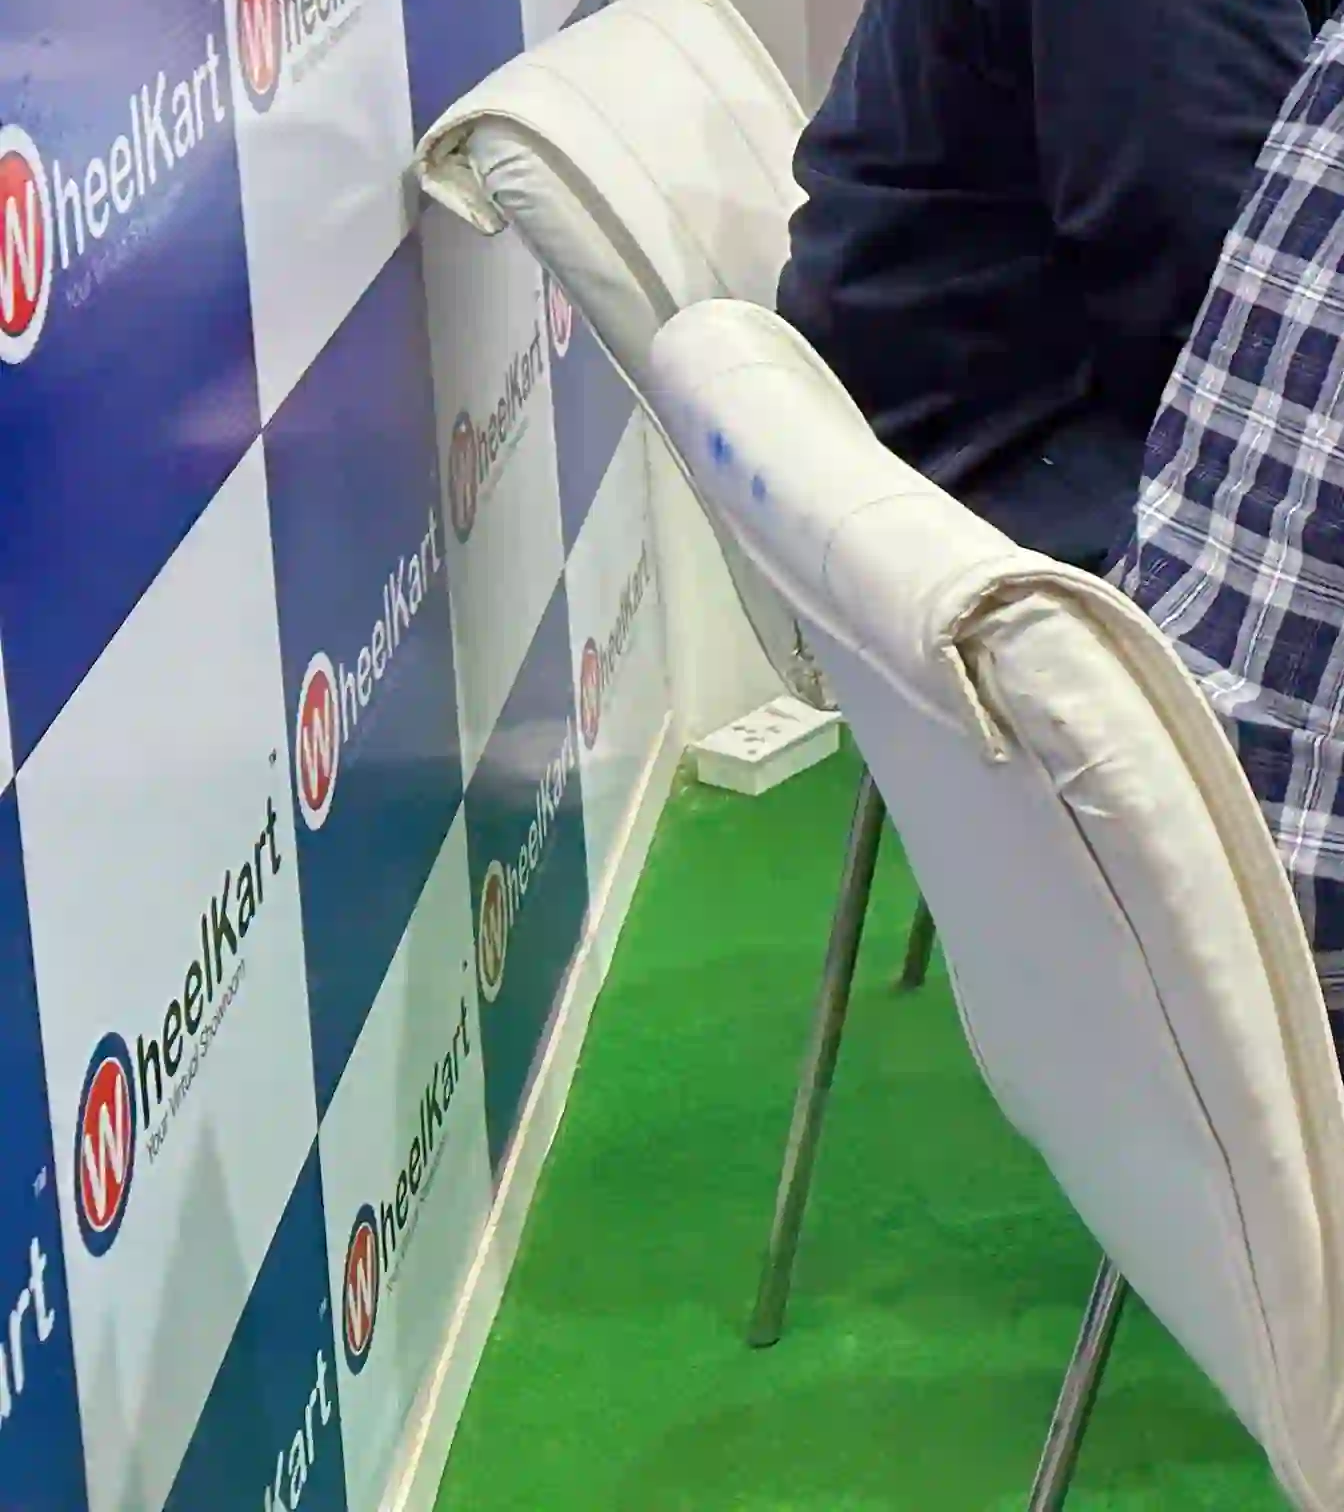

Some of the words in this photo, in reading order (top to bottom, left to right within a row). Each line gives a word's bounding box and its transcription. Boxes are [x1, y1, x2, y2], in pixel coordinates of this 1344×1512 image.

[303, 508, 443, 800] WheelKart
[84, 795, 282, 1221] WheelKart
[145, 1112, 170, 1164] Your
[200, 958, 247, 1058] Showroom
[346, 995, 472, 1349] WheelKart
